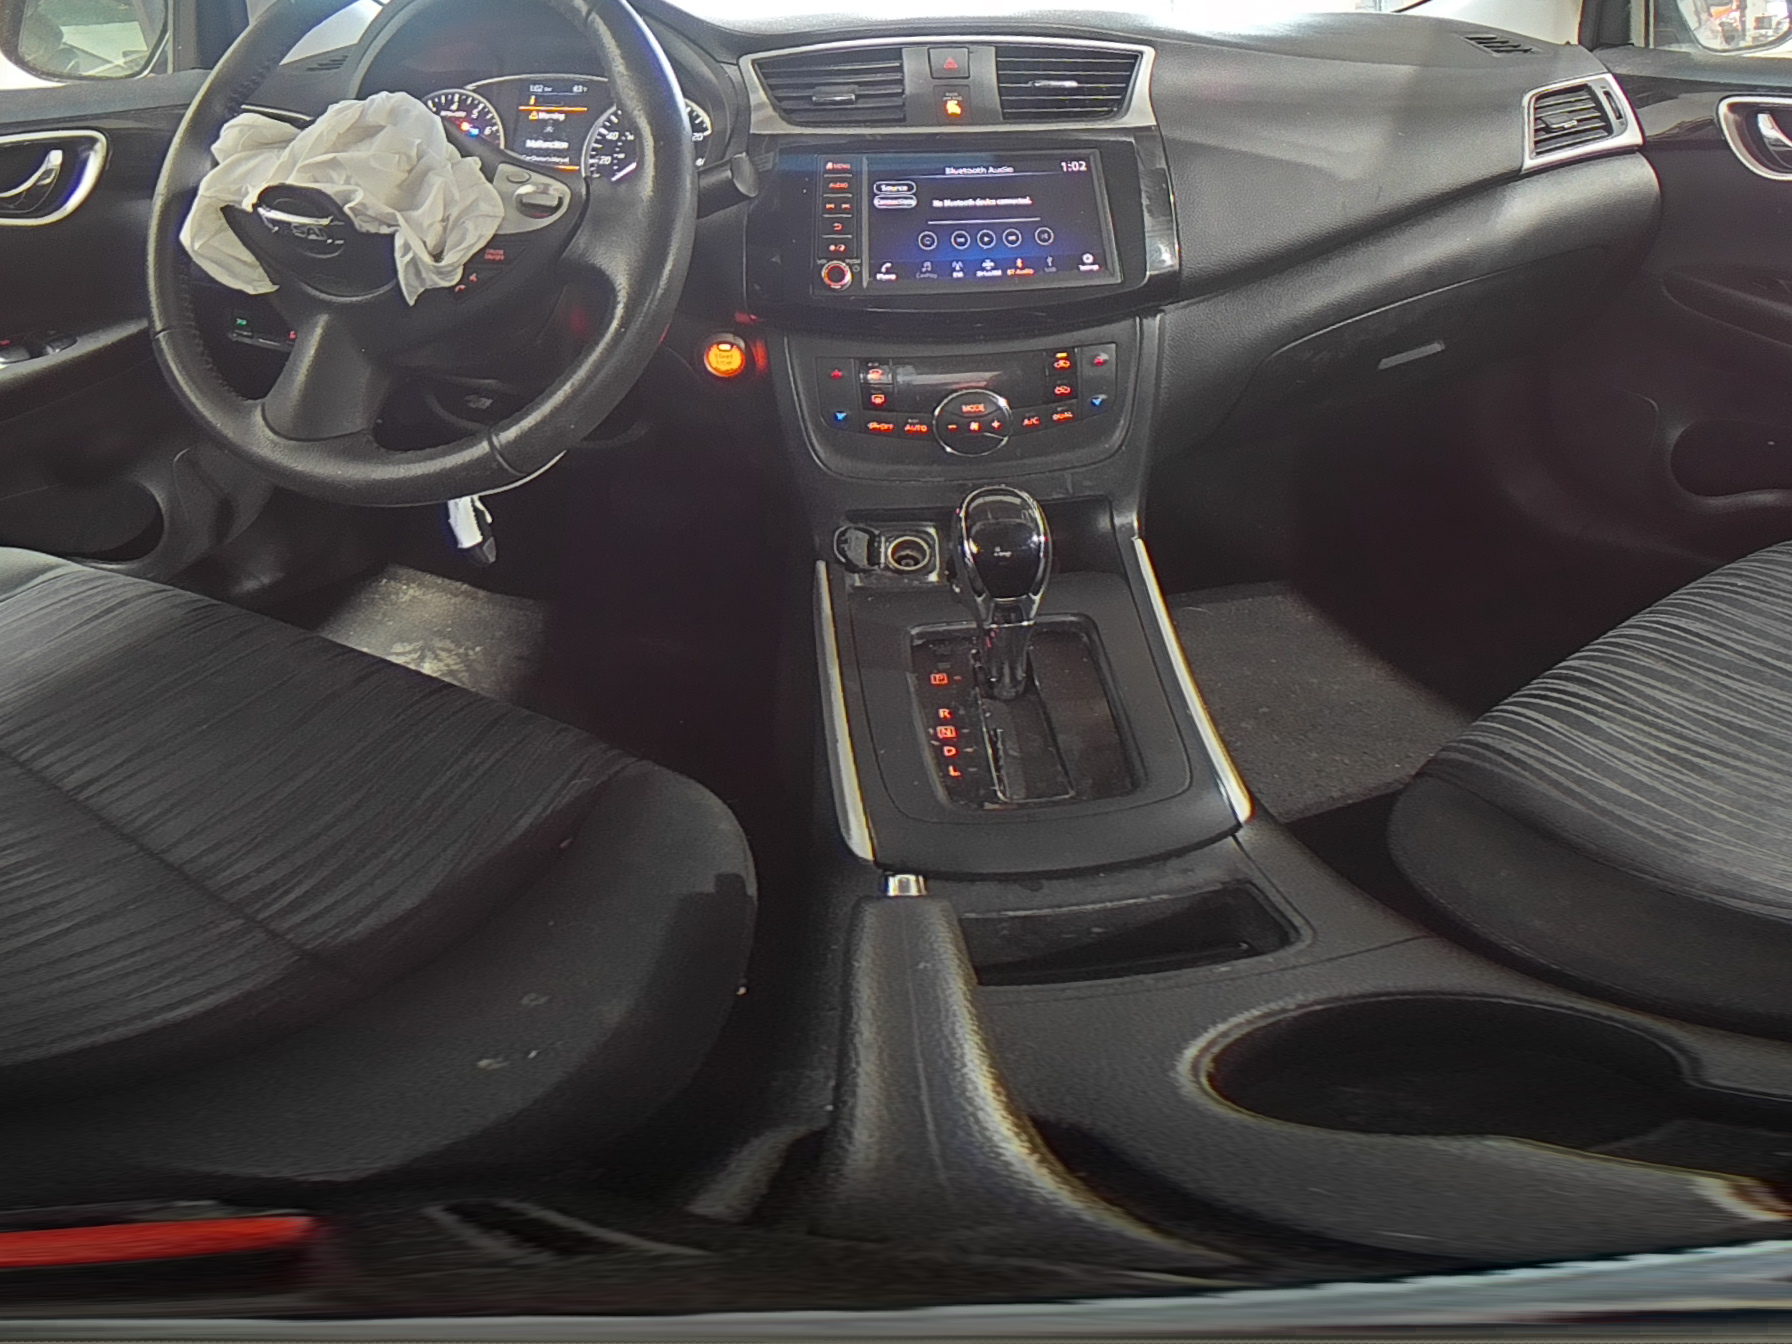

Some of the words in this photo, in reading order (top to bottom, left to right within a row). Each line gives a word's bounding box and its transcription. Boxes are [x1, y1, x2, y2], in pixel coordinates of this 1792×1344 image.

[605, 131, 619, 140] 40
[599, 156, 612, 164] 20
[1061, 161, 1088, 172] 1:02
[961, 403, 985, 413] MODE
[1022, 417, 1040, 427] A/C
[904, 423, 928, 433] AUTO
[938, 708, 951, 718] R
[943, 745, 957, 757] D
[949, 765, 961, 776] L
